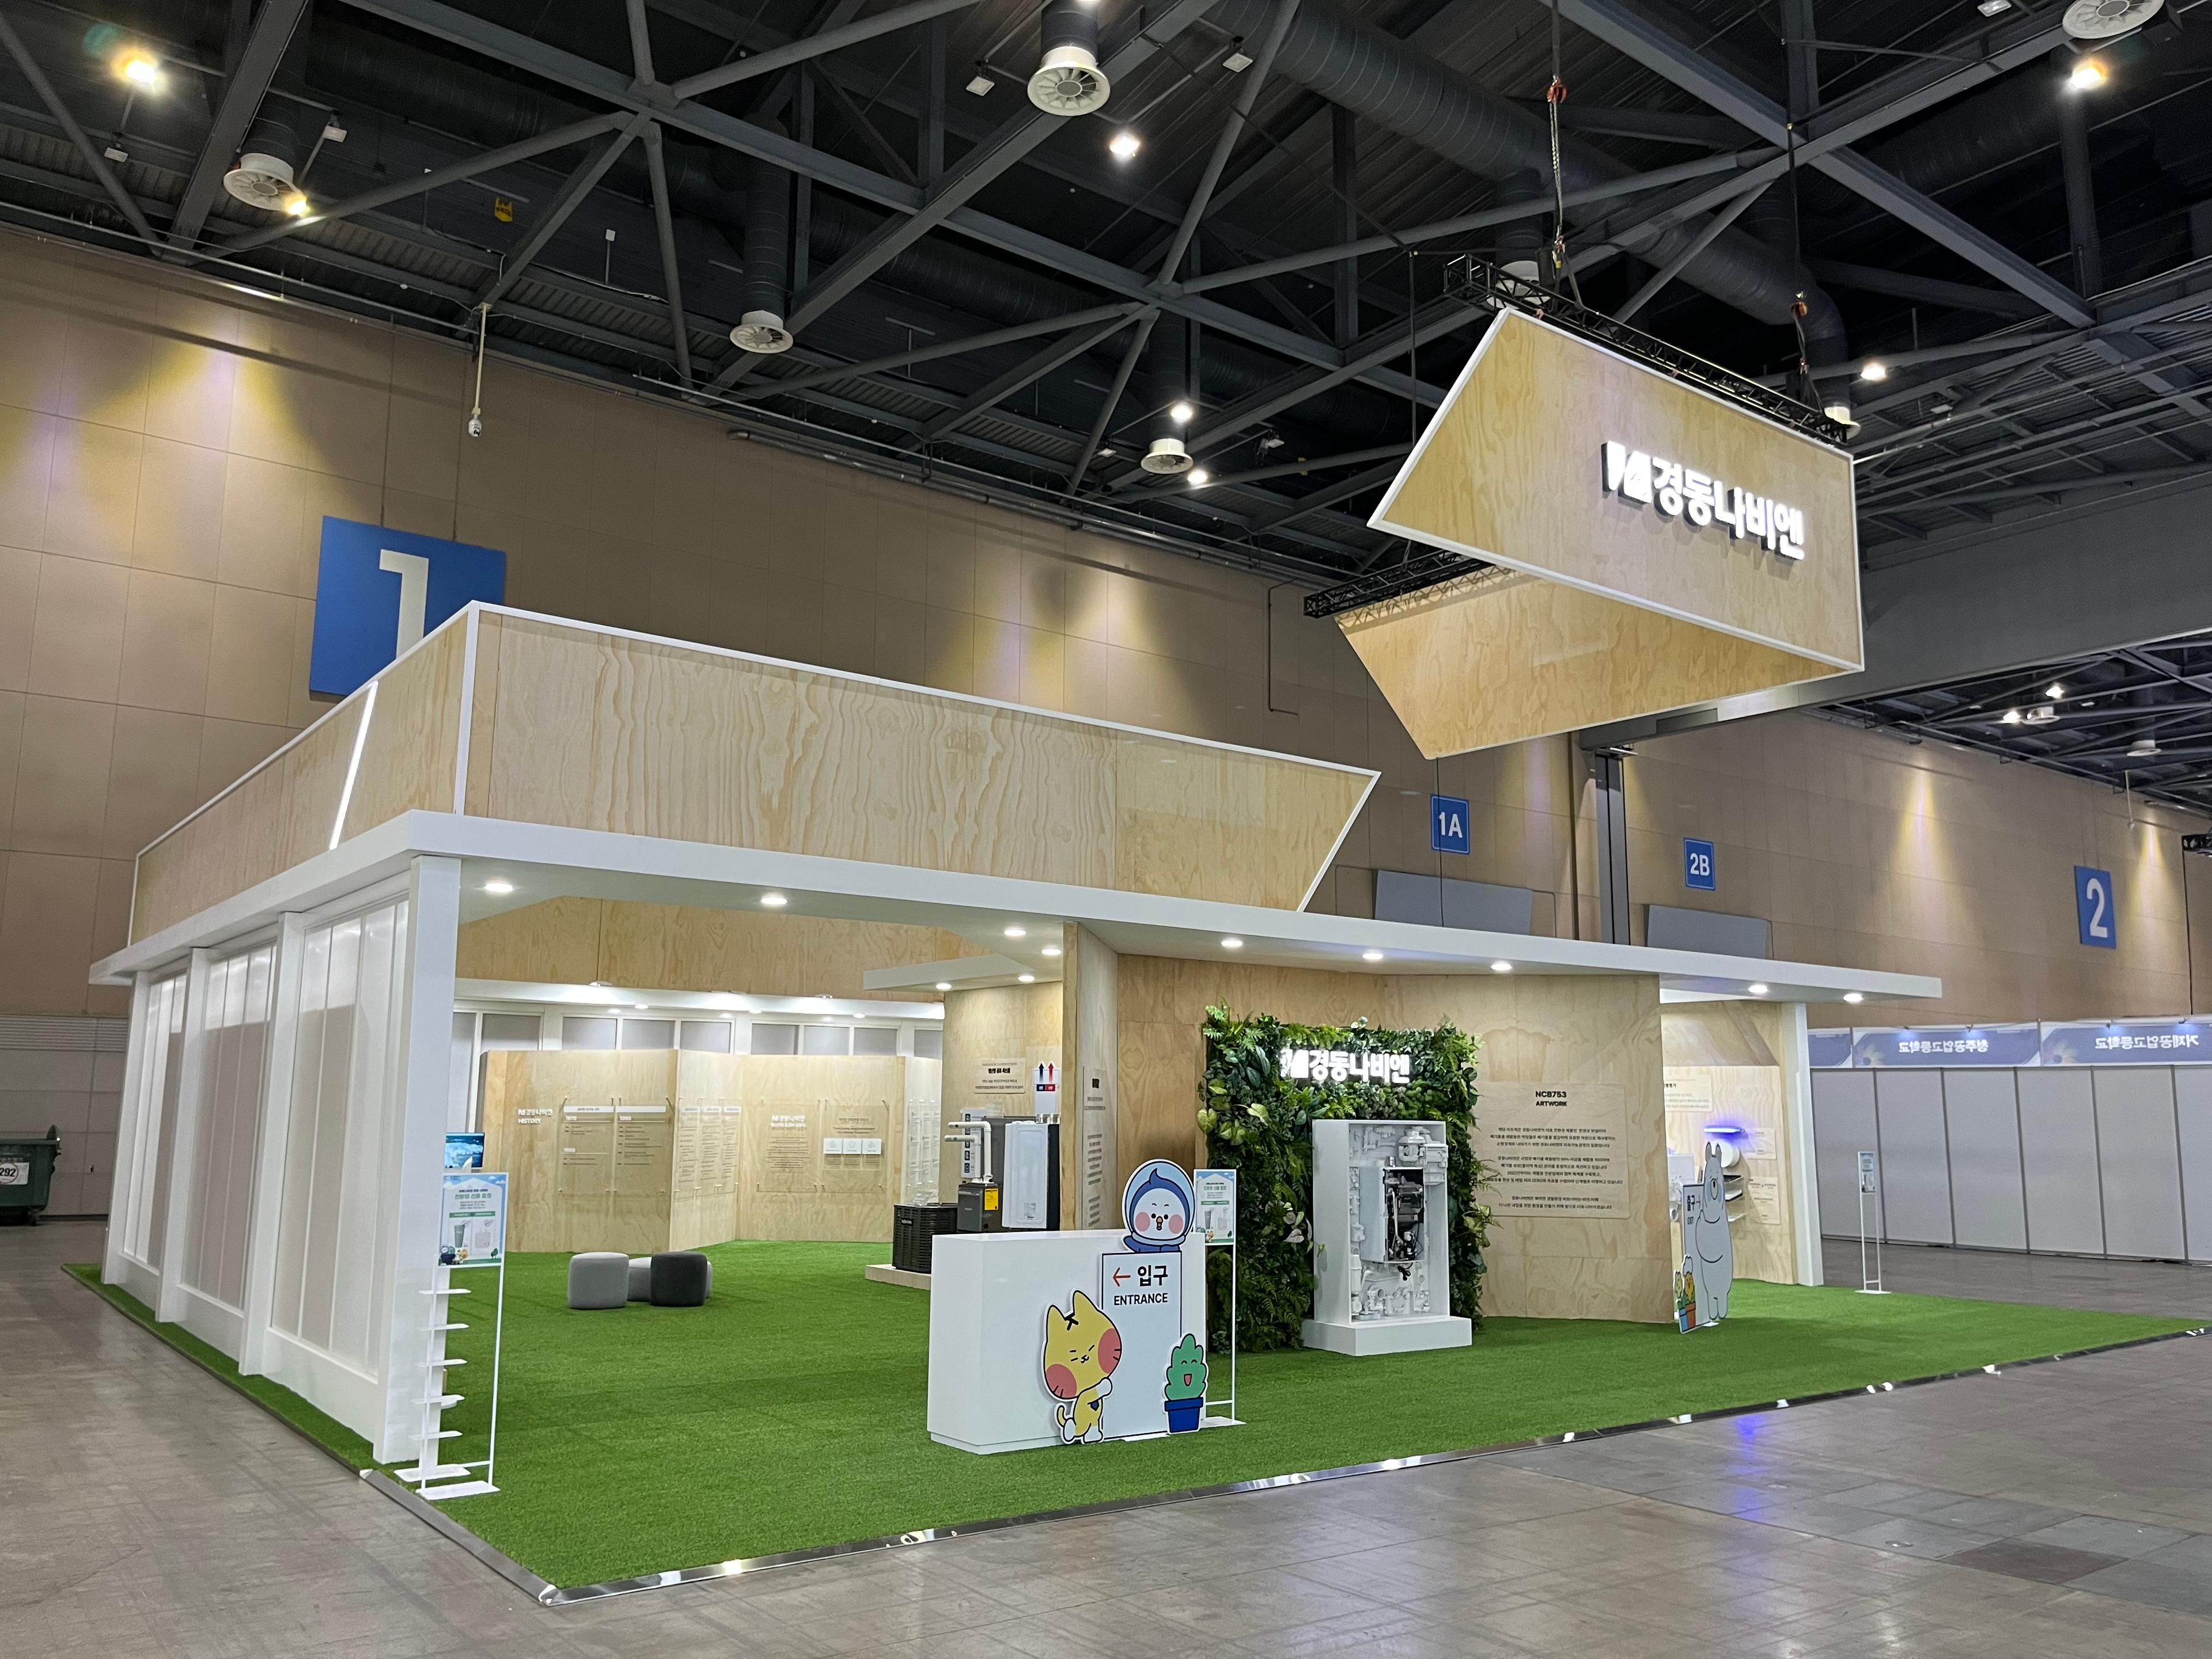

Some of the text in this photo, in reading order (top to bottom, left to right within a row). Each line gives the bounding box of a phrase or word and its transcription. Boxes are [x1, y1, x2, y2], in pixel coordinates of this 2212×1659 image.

[1652, 456, 1804, 560] 경동나비엔
[380, 549, 429, 658] 1
[1438, 812, 1463, 838] 1A
[1690, 853, 1710, 877] 2B
[2086, 878, 2108, 938] 2
[1309, 1050, 1410, 1084] 경동나비엔
[1535, 1090, 1567, 1099] NCB753
[1137, 1265, 1168, 1287] 입구
[1114, 1293, 1168, 1306] ENTRANCE
